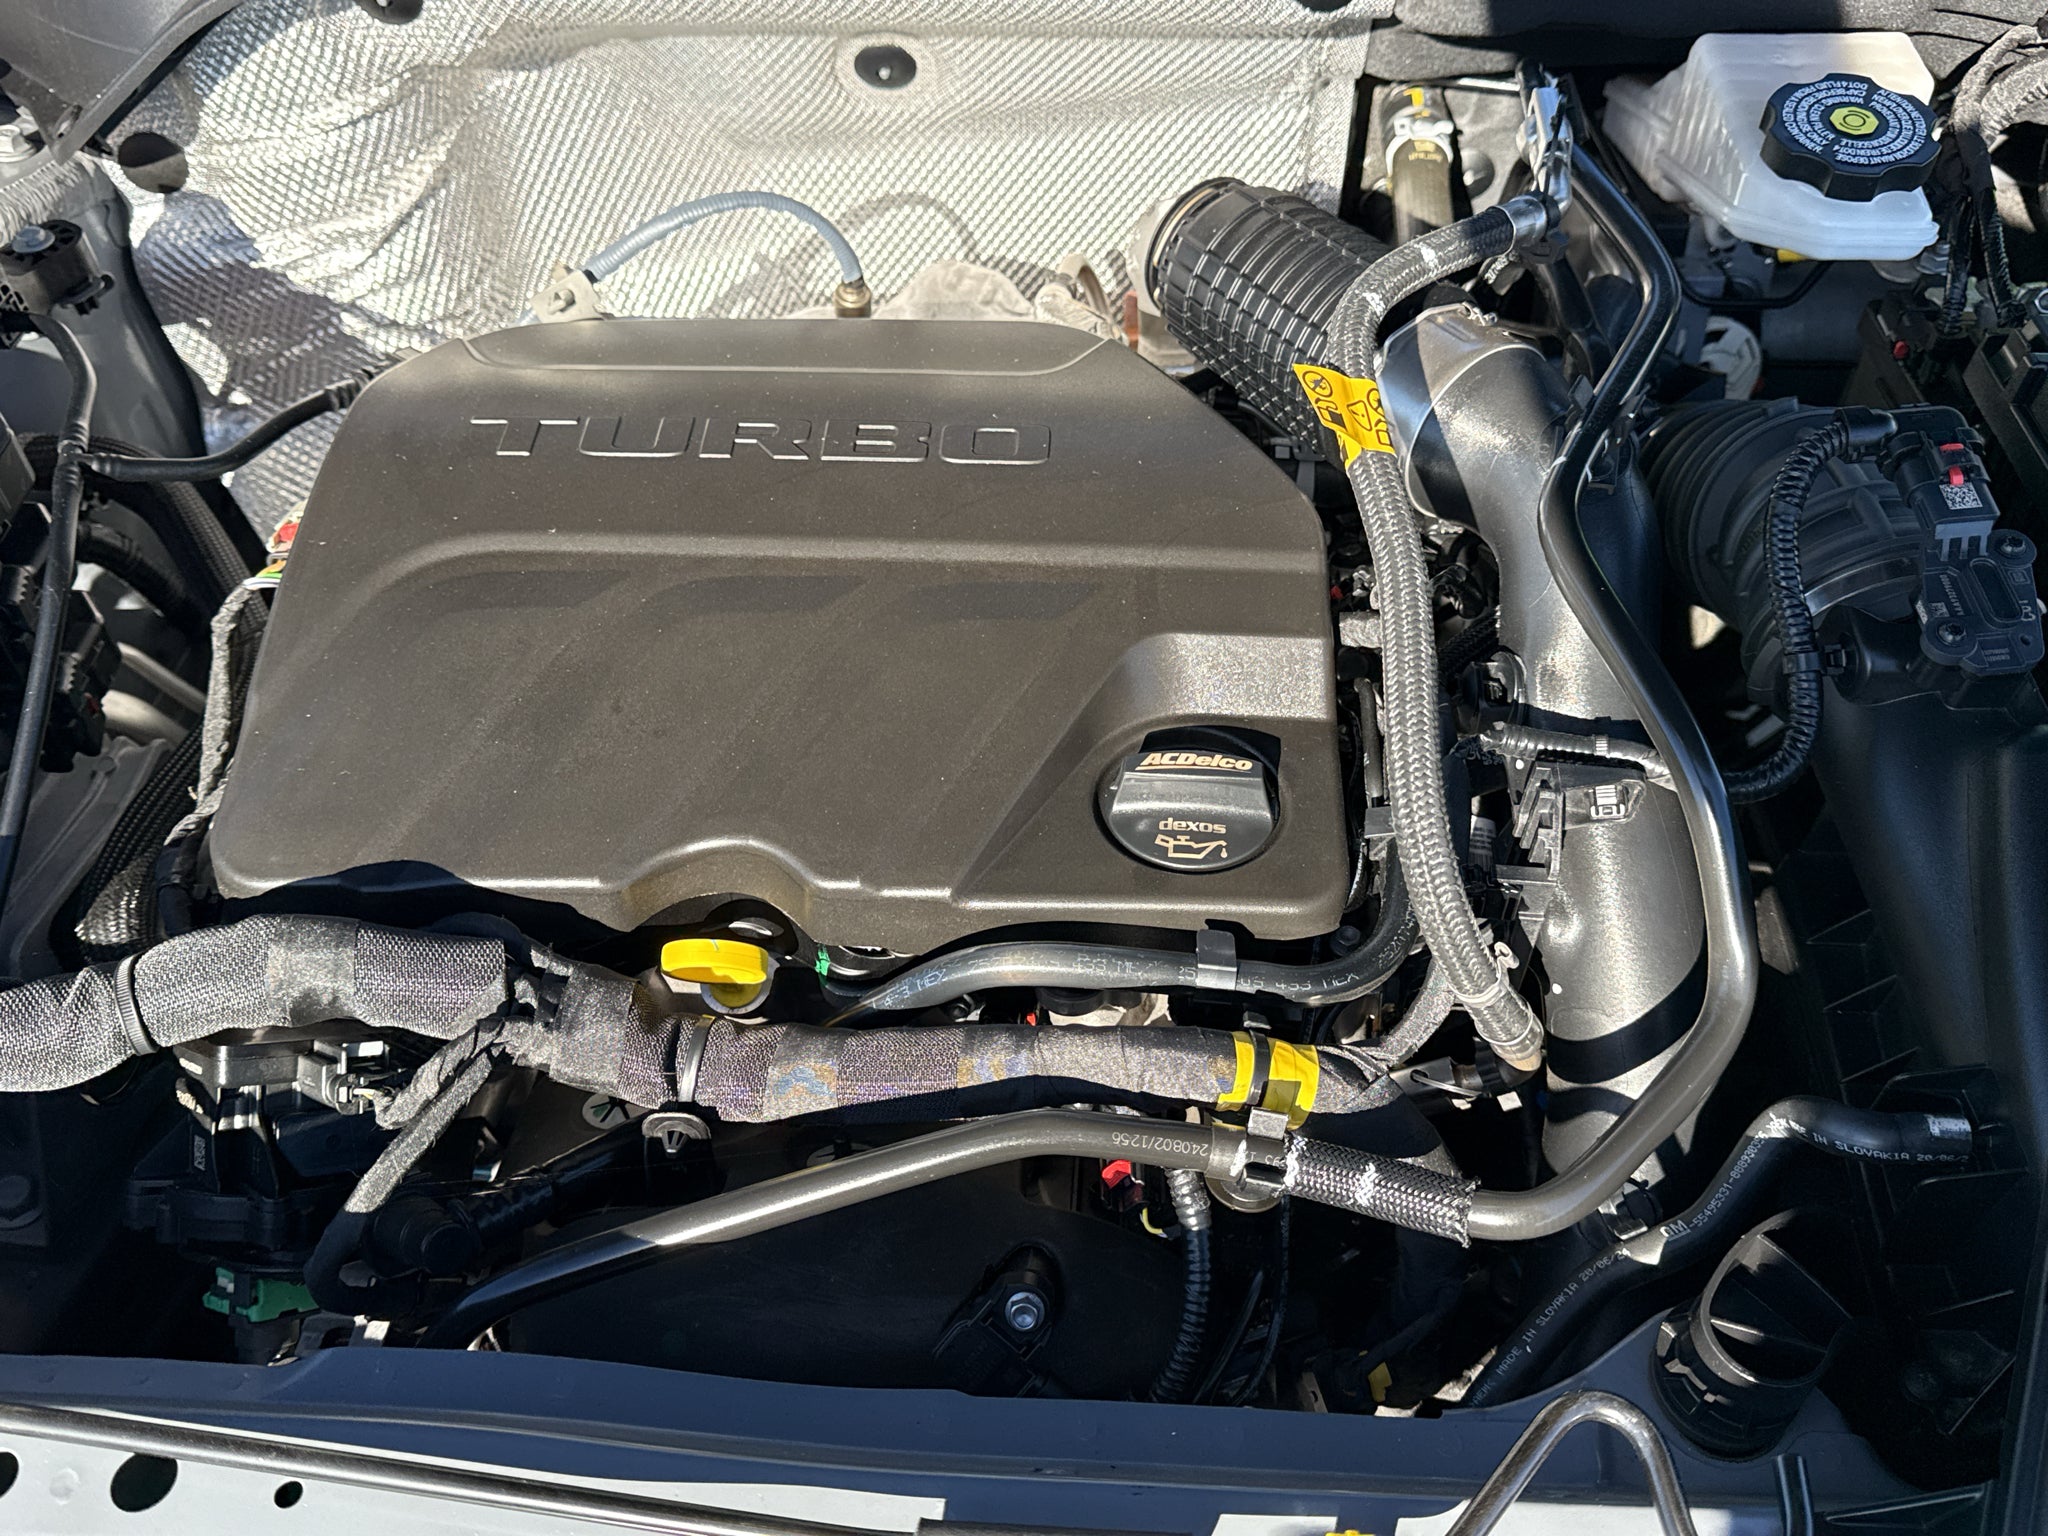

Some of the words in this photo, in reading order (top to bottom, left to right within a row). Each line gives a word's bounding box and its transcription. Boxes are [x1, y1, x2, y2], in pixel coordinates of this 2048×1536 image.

[1793, 86, 1816, 98] FROM
[1810, 88, 1846, 100] BEFORE
[1782, 100, 1796, 121] SEALED
[1809, 103, 1825, 121] CLEAN
[1798, 121, 1812, 132] USE
[1811, 122, 1835, 140] FILLER
[1807, 132, 1829, 145] ONLY
[1869, 154, 1895, 164] AVANT
[470, 416, 1051, 465] TURBO
[1140, 752, 1253, 771] ACDelco
[1158, 817, 1227, 834] dexos
[1811, 1132, 1829, 1147] IN
[1835, 1140, 1910, 1162] SLOVAKIA
[1495, 1346, 1525, 1376] MADE
[1521, 1326, 1538, 1345] IN
[1534, 1279, 1581, 1327] SLOVAKIA
